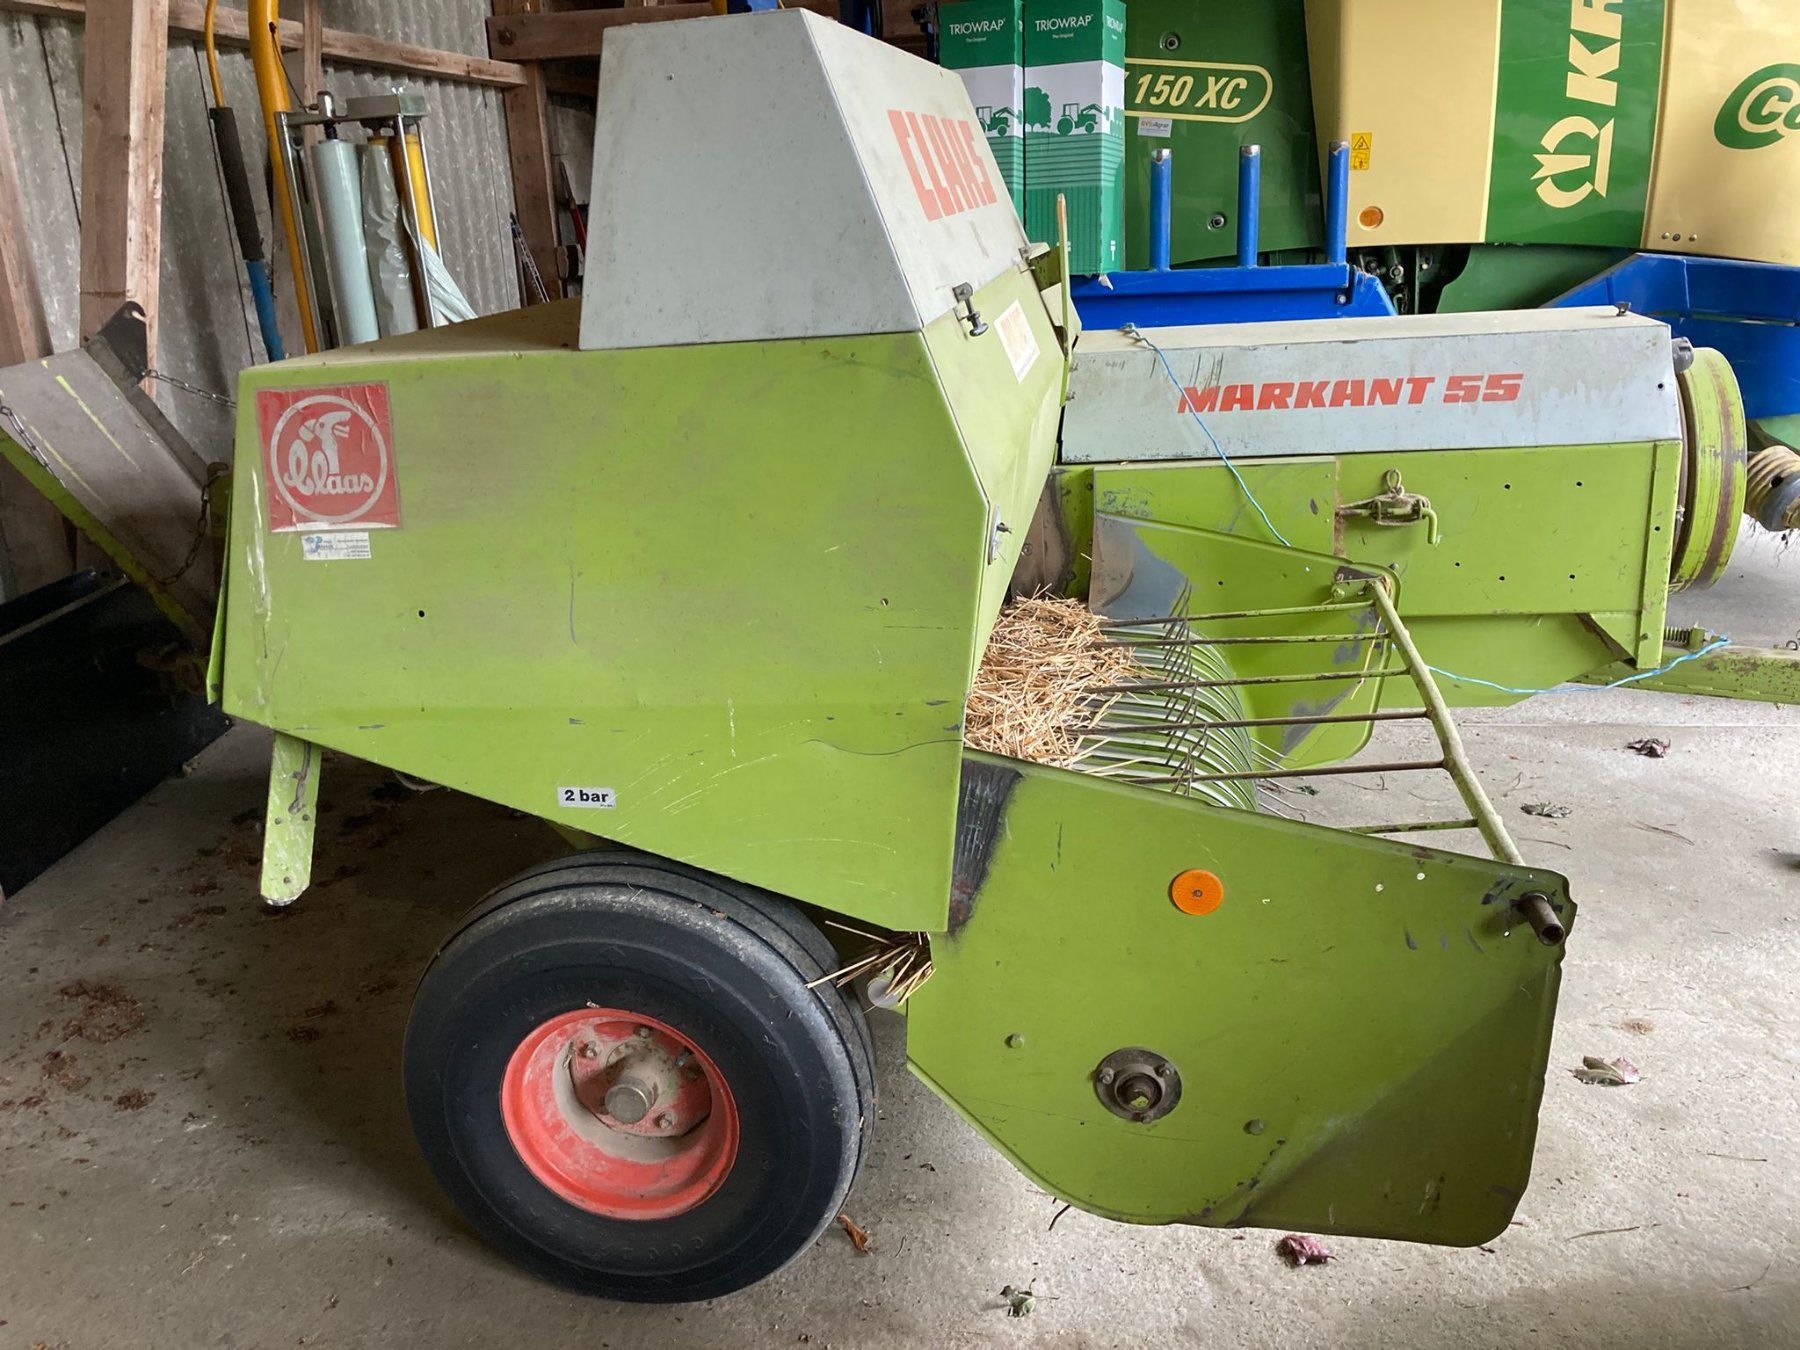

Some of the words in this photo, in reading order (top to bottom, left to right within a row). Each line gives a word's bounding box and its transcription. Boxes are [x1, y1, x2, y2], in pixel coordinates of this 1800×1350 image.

[949, 19, 1005, 35] TRIOWRAP
[1035, 15, 1092, 32] TRIOWRAP
[1134, 73, 1194, 107] 150
[1194, 76, 1248, 110] XC
[887, 109, 997, 222] CLAAS
[1177, 376, 1436, 414] MARKANT
[1443, 373, 1524, 404] 55
[564, 789, 575, 801] 2
[579, 789, 609, 803] bar
